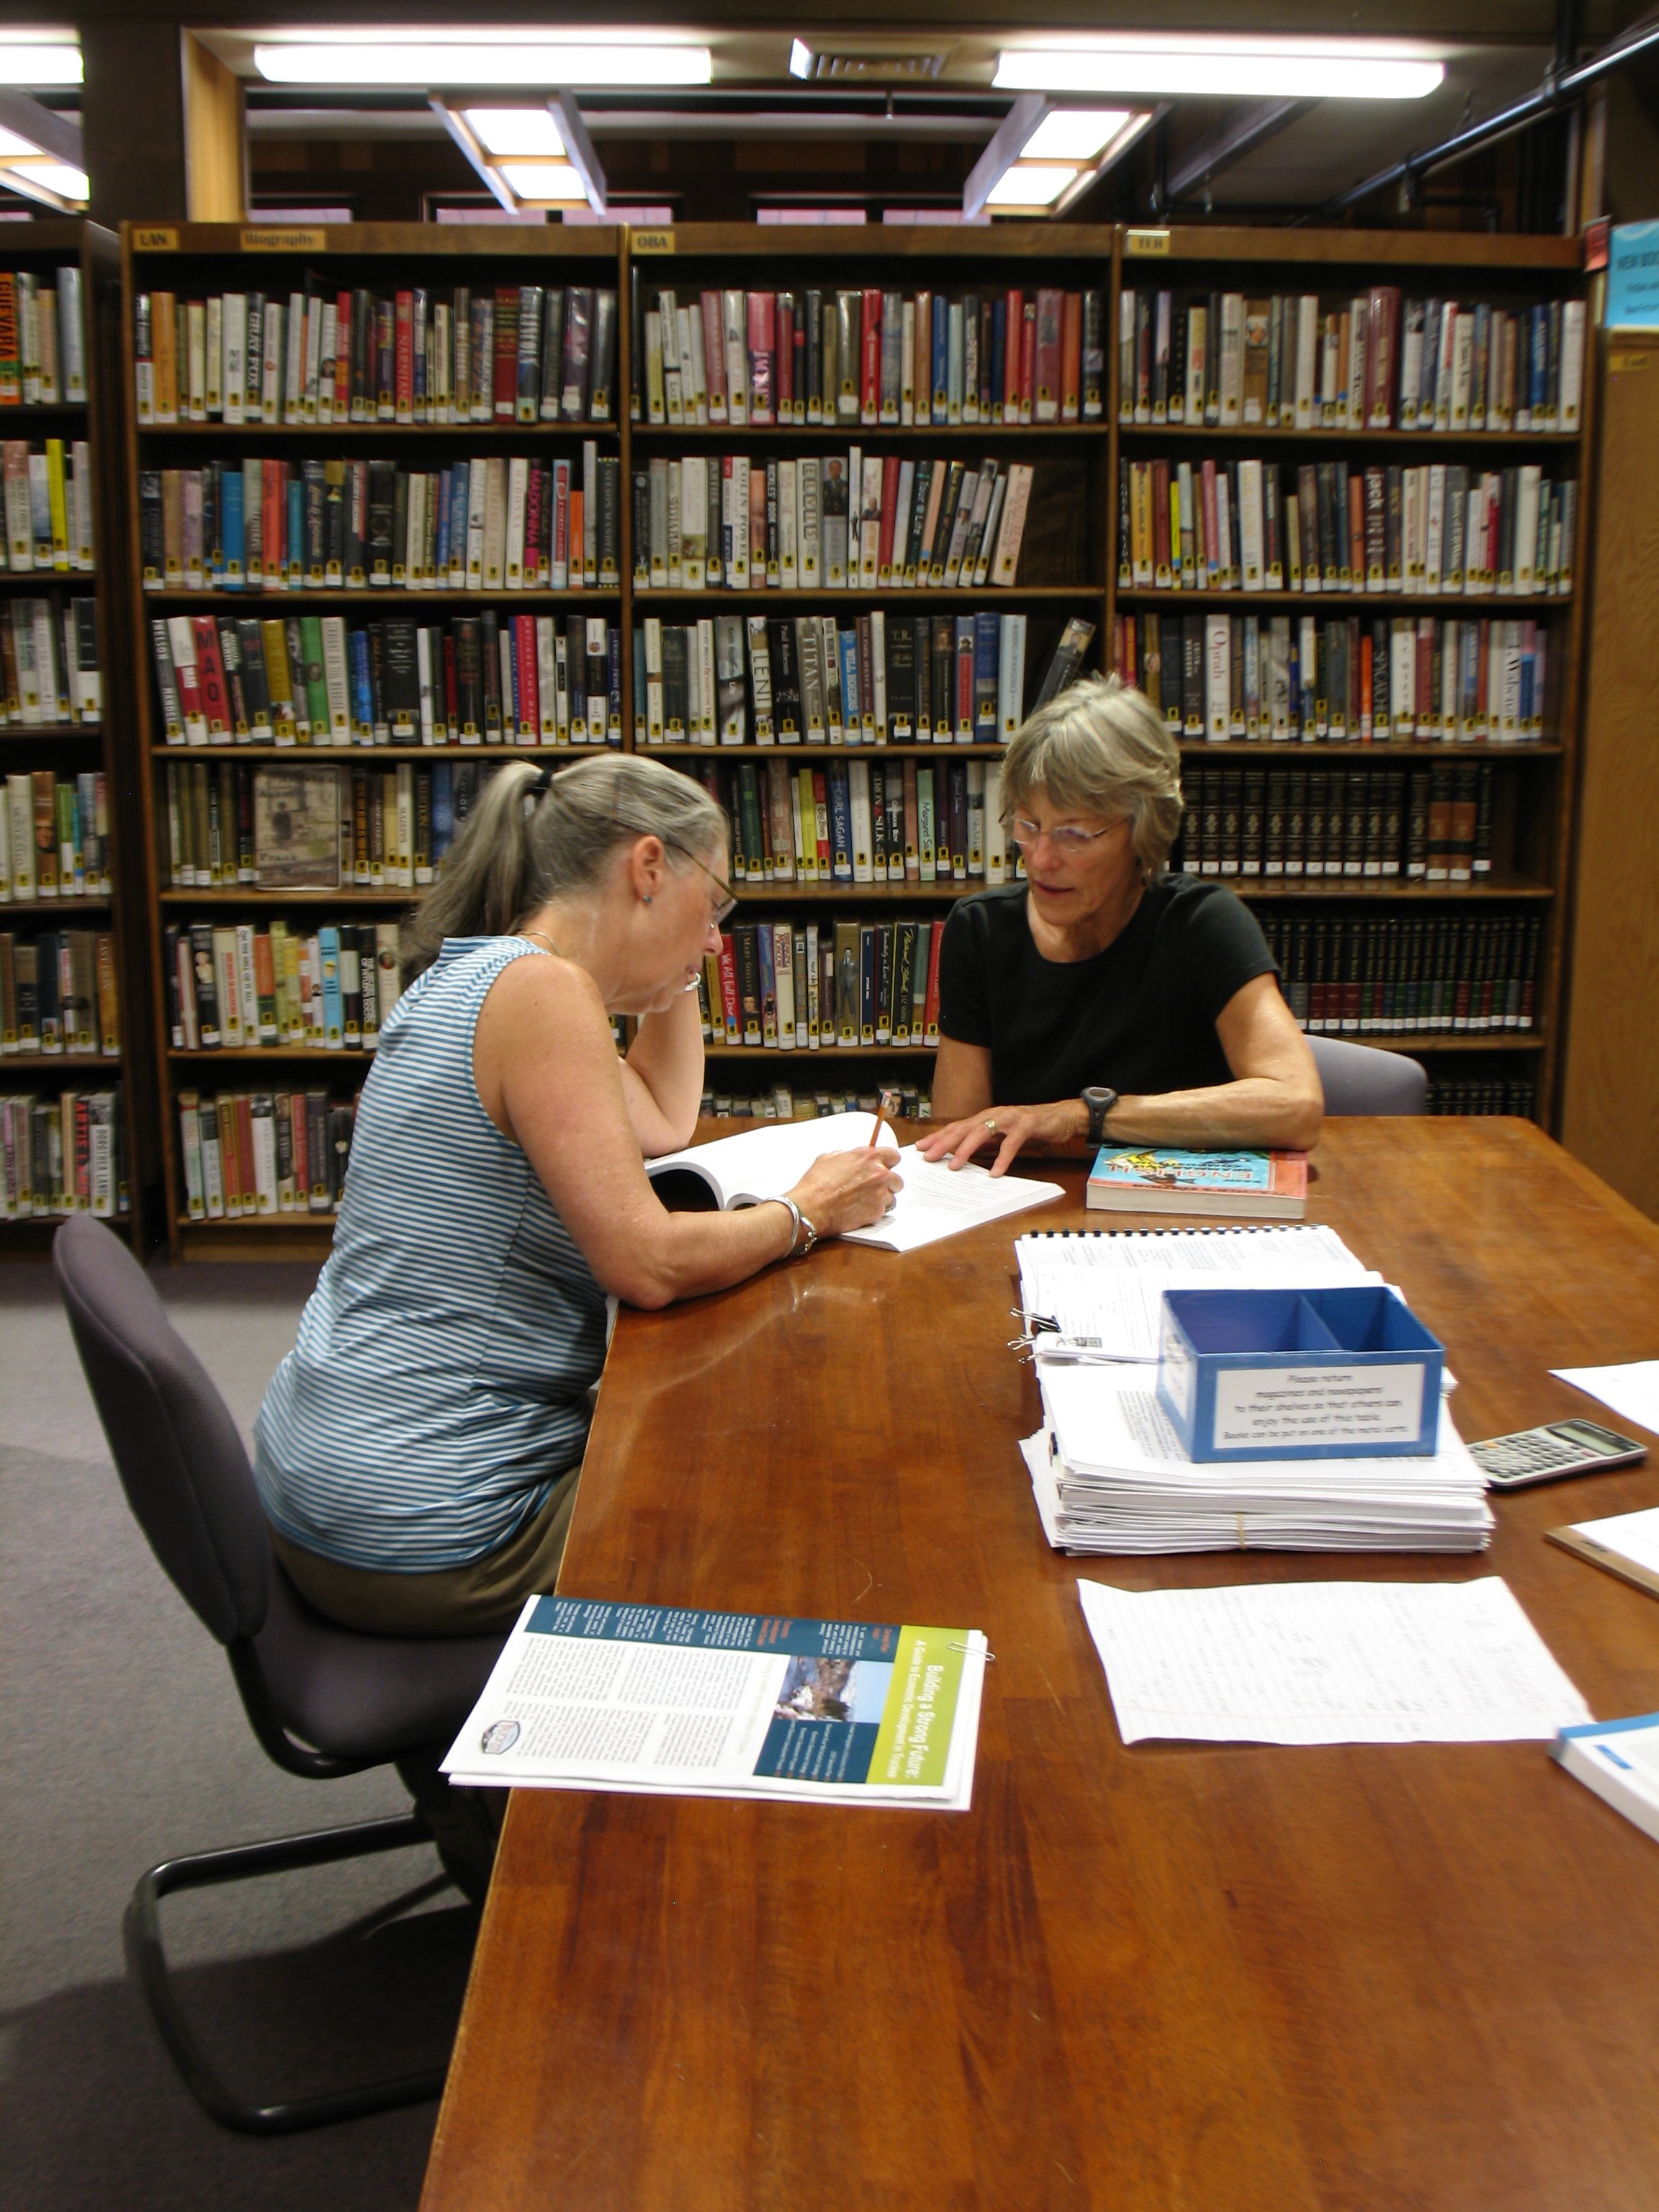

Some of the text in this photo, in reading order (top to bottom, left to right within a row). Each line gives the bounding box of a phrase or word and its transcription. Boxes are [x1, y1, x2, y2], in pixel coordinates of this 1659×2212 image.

[245, 231, 315, 247] Biography
[248, 312, 261, 387] GRAY FOX
[526, 469, 540, 544] MADONNA
[803, 464, 817, 540] ELVIS
[740, 516, 749, 562] POWEL
[196, 631, 219, 701] MAO
[220, 630, 233, 670] WARRIOR
[804, 634, 817, 690] TITAN
[1209, 631, 1228, 680] Oprah
[154, 624, 177, 724] NELSON MANDEL
[182, 667, 196, 688] MAO
[754, 656, 770, 701] LENI
[846, 649, 857, 711] WILL ROGERS
[873, 778, 884, 805] IRON
[836, 816, 845, 847] SAGAN
[876, 815, 884, 842] SILK
[921, 802, 930, 837] Margaret
[99, 938, 108, 960] LAST
[721, 954, 729, 964] We
[775, 933, 784, 967] MOSCOW
[723, 967, 732, 977] All
[723, 980, 733, 994] Fall
[75, 1102, 88, 1148] ARTIE
[96, 1129, 109, 1197] DOROTHEA LANG
[1105, 1164, 1253, 1179] ENGLISH
[912, 1647, 924, 1665] Guide
[903, 1673, 920, 1702] Economic
[917, 1665, 944, 1701] Building
[908, 1712, 935, 1742] Strong
